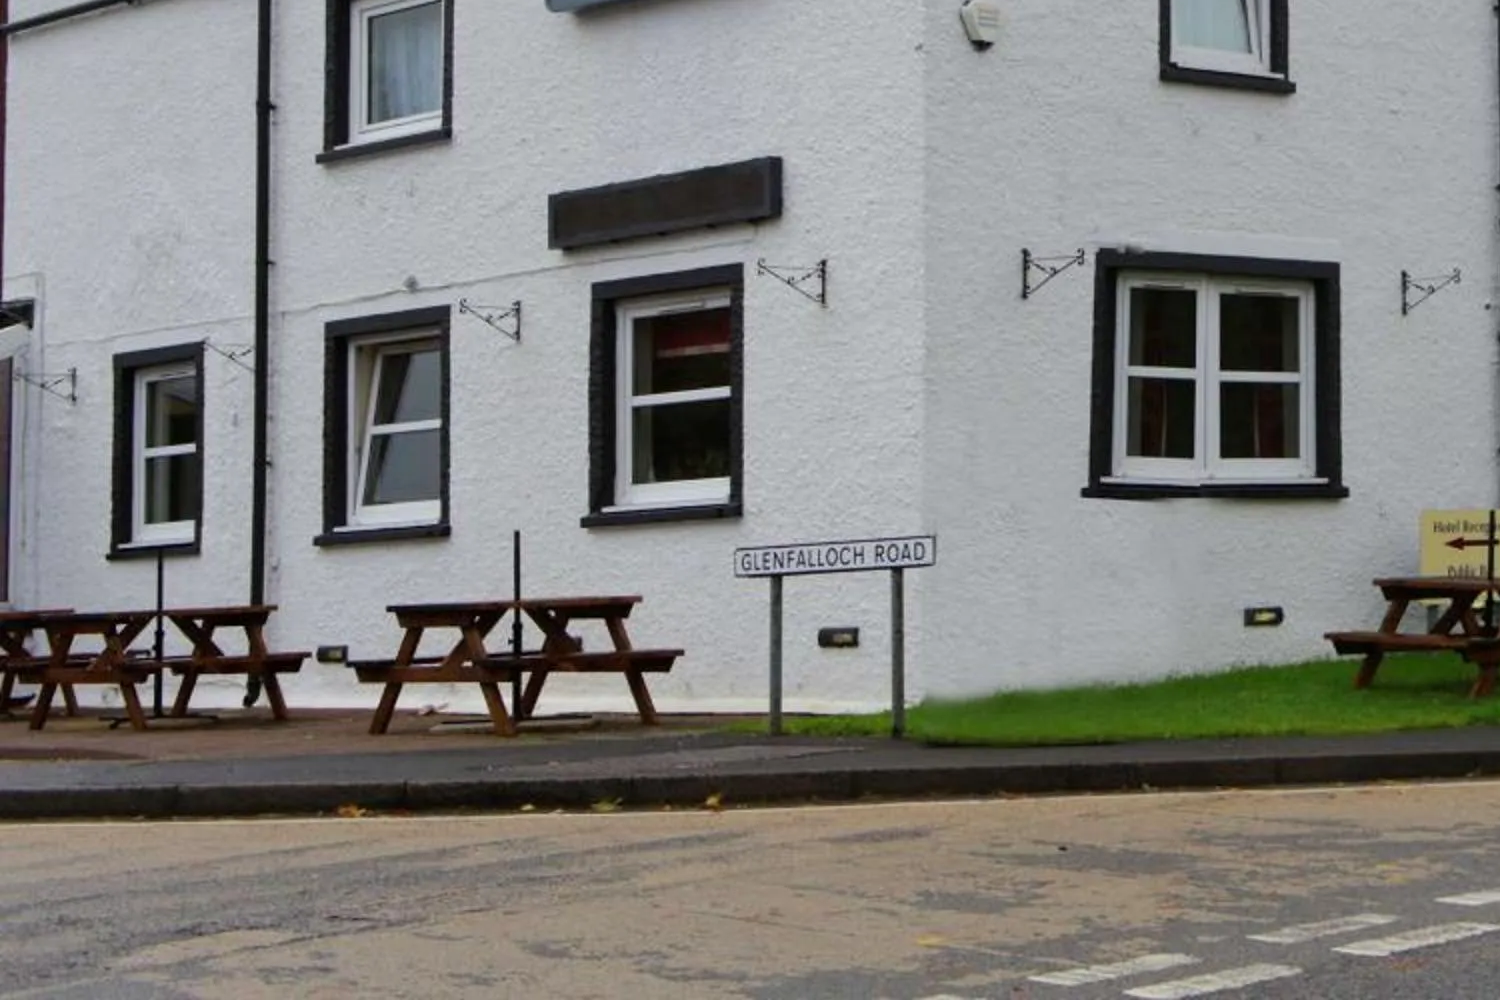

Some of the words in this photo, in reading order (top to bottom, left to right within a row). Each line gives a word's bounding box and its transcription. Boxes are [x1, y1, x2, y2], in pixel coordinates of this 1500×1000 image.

[1433, 520, 1460, 533] Hotel
[741, 545, 865, 571] GLENFALLOCH
[874, 541, 925, 563] ROAD
